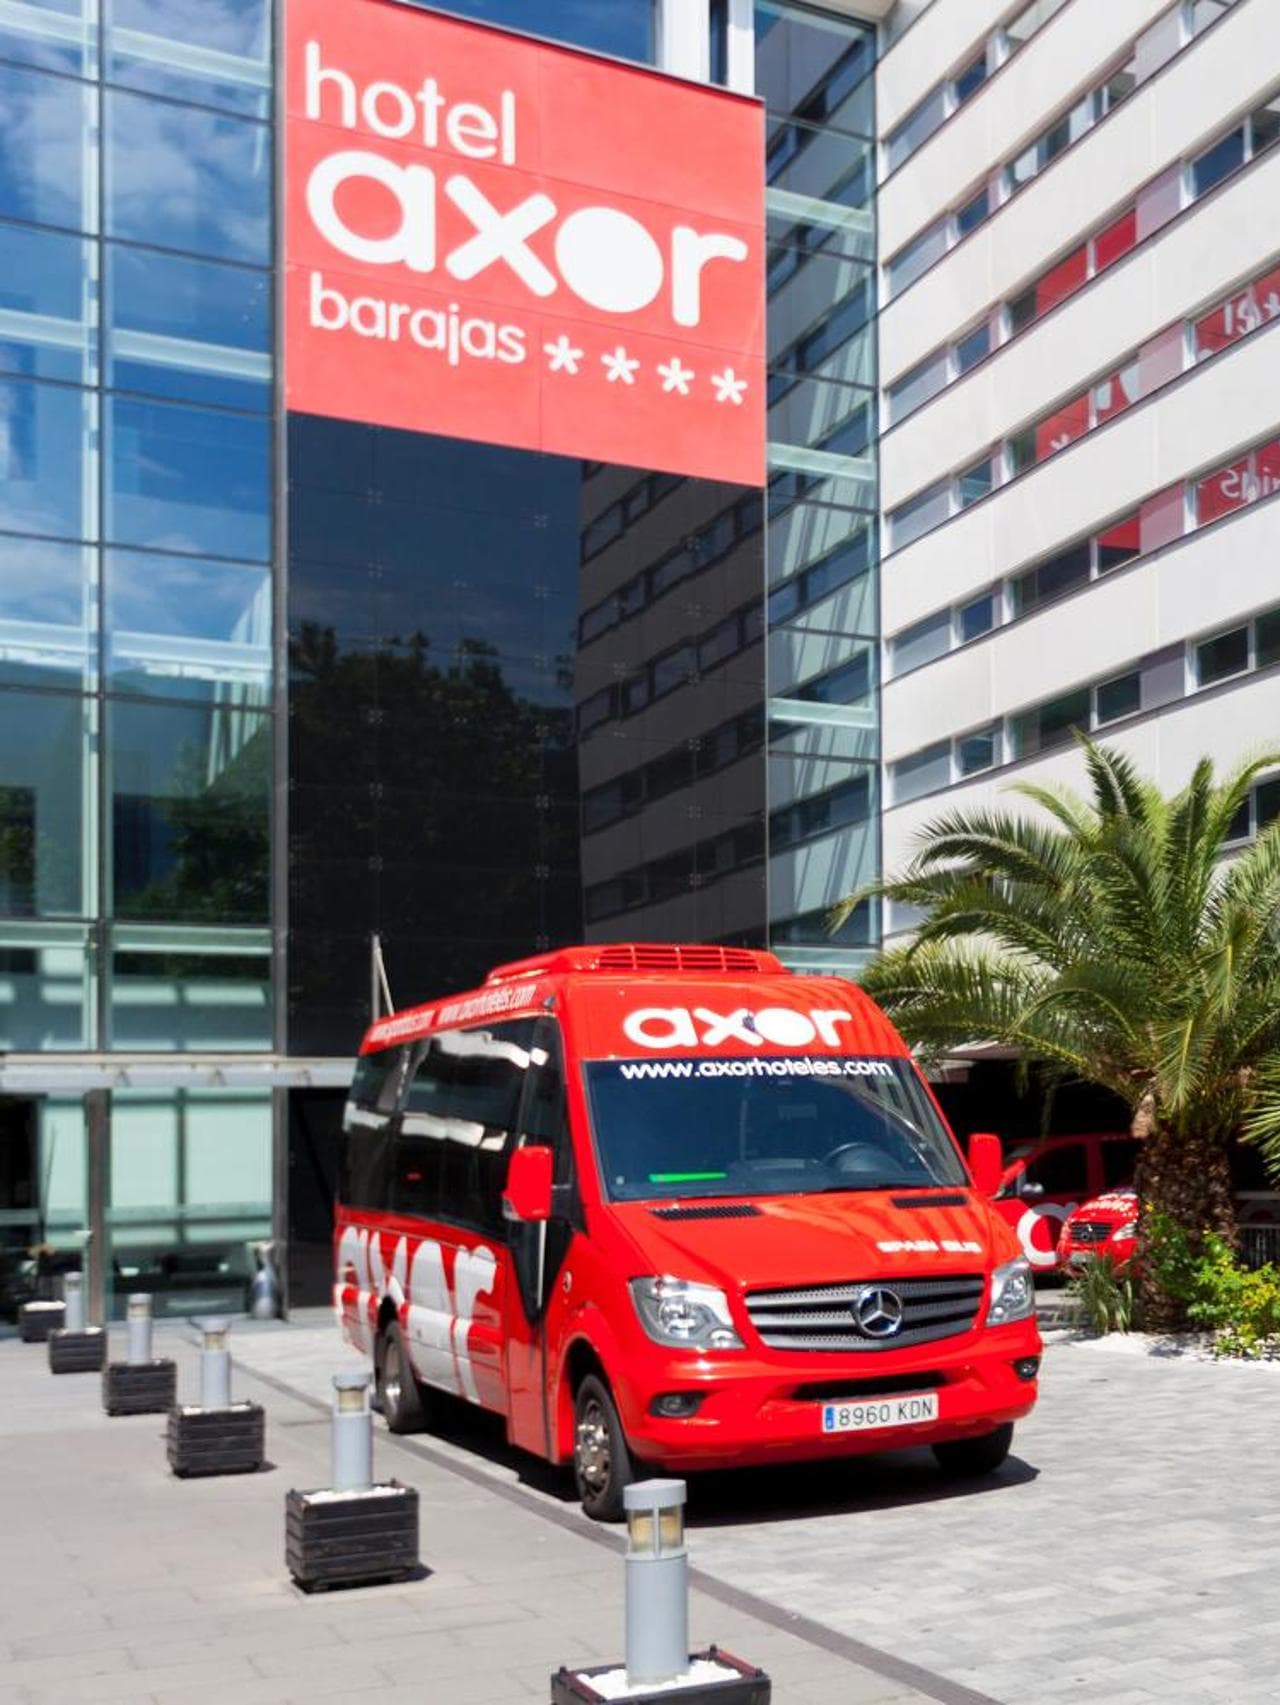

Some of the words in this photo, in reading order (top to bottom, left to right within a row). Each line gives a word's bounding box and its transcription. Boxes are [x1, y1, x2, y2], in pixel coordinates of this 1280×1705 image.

[306, 40, 515, 165] hotel
[306, 150, 748, 328] axor
[310, 272, 526, 366] barajas
[623, 1007, 852, 1049] axor
[620, 1057, 893, 1081] www.axorhoteles.com
[839, 1404, 890, 1426] 8960
[898, 1398, 933, 1420] KDN
